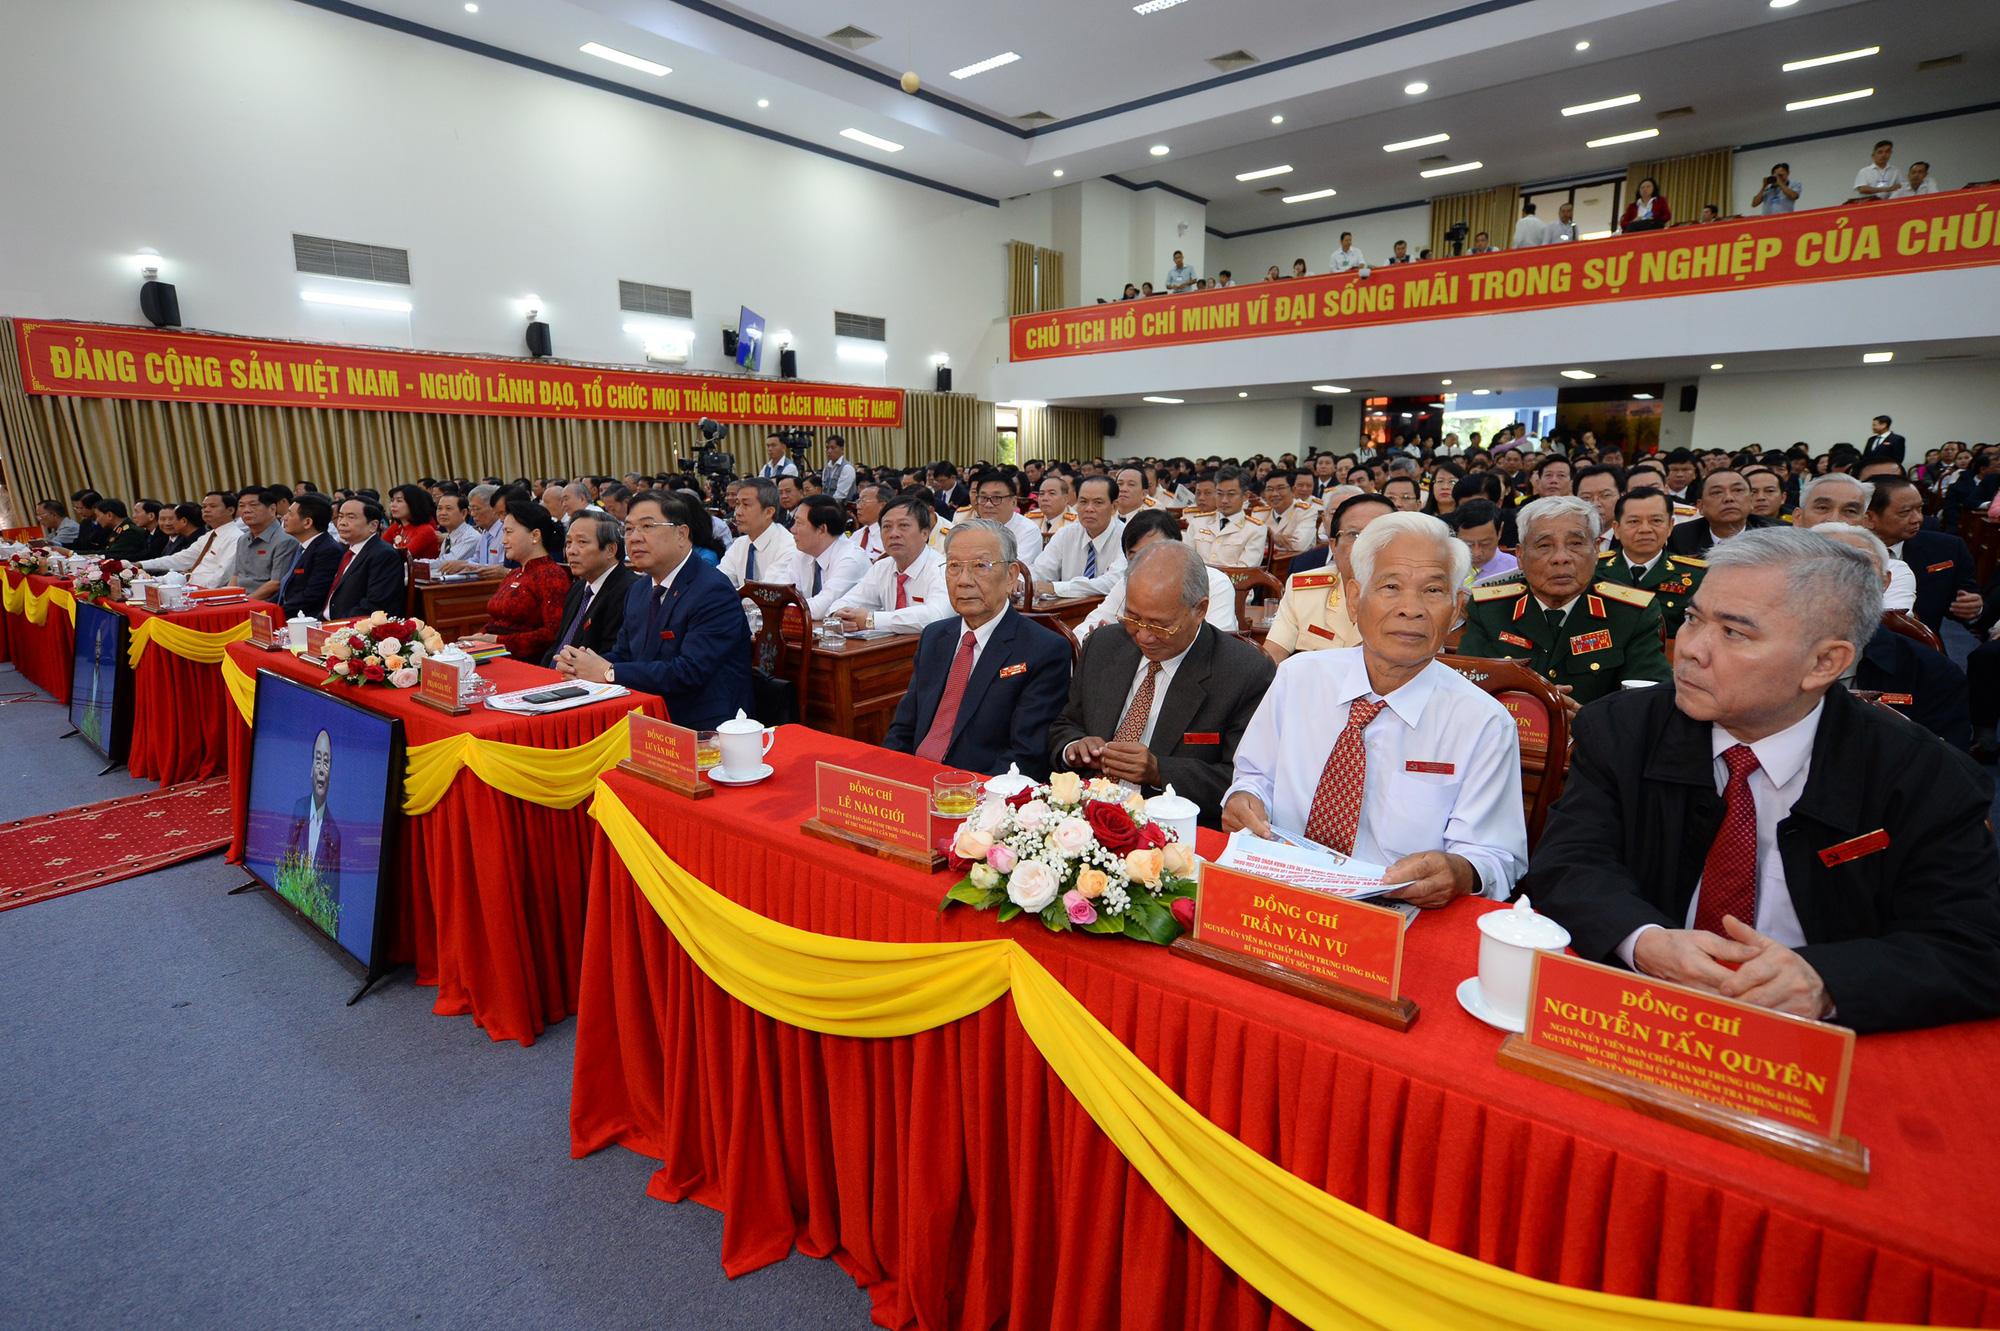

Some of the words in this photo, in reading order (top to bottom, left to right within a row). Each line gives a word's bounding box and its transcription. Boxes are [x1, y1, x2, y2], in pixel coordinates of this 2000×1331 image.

[1026, 318, 1060, 350] CHỦ
[1065, 320, 1105, 349] TỊCH
[1111, 308, 1136, 341] HỒ
[1142, 306, 1176, 337] CHÍ
[1182, 302, 1240, 333] MINH
[1247, 294, 1270, 325] VĨ
[1275, 293, 1316, 326] ĐẠI
[1323, 278, 1395, 317] SỐNG
[1404, 272, 1460, 309] MÃI
[1469, 263, 1571, 302] TRONG
[1583, 252, 1634, 294] SỰ
[1640, 234, 1783, 284] NGHIỆP
[1796, 217, 1881, 267] CỦA
[1898, 203, 2000, 256] CHÚ
[49, 336, 137, 383] ĐẢNG
[145, 347, 222, 392] CỘNG
[230, 349, 284, 391] SẢN
[290, 359, 340, 399] VIỆT
[347, 368, 399, 398] NAM
[420, 369, 482, 402] NGƯỜI
[487, 373, 536, 404] LÃNH
[540, 381, 579, 411] ĐẠO,
[583, 375, 603, 408] TỔ
[608, 382, 648, 410] CHỨC
[653, 388, 681, 415] MỌI
[683, 383, 727, 413] THẮNG
[731, 391, 751, 418] LỢI
[754, 388, 779, 415] CỦA
[781, 392, 811, 416] CÁCH
[814, 397, 847, 421] MẠNG
[849, 396, 870, 422] VIỆT
[872, 400, 896, 419] NAM!
[1503, 702, 1519, 711] HÍ
[838, 795, 852, 809] LÊ
[854, 800, 879, 817] NAM
[880, 808, 905, 824] GIỚI
[849, 780, 874, 797] ĐỒNG
[876, 789, 893, 802] CHÍ
[1253, 893, 1301, 919] ĐỒNG
[1306, 911, 1339, 929] CHÍ
[1203, 922, 1230, 936] NGUYÊN
[1230, 930, 1241, 939] ỦY
[1241, 933, 1258, 944] VIÊN
[1258, 939, 1273, 949] BAN
[1273, 943, 1293, 954] CHẤP
[1294, 949, 1316, 961] HÀNH
[1316, 956, 1341, 969] TRUNG
[1342, 963, 1364, 976] ƯƠNG
[1240, 914, 1283, 937] TRẦN
[1287, 927, 1321, 948] VĂN
[1325, 937, 1348, 957] VỤ
[1243, 943, 1252, 952] BÍ
[1252, 946, 1268, 956] THƯ
[1267, 951, 1285, 962] TỈNH
[1285, 955, 1296, 965] ỦY
[1296, 959, 1311, 969] SÓC
[1621, 988, 1689, 1022] ĐỒNG
[1695, 1012, 1742, 1037] CHÍ
[1544, 996, 1651, 1043] NGUYỄN
[1656, 1028, 1715, 1062] TẤN
[1720, 1049, 1827, 1095] QUYÊN
